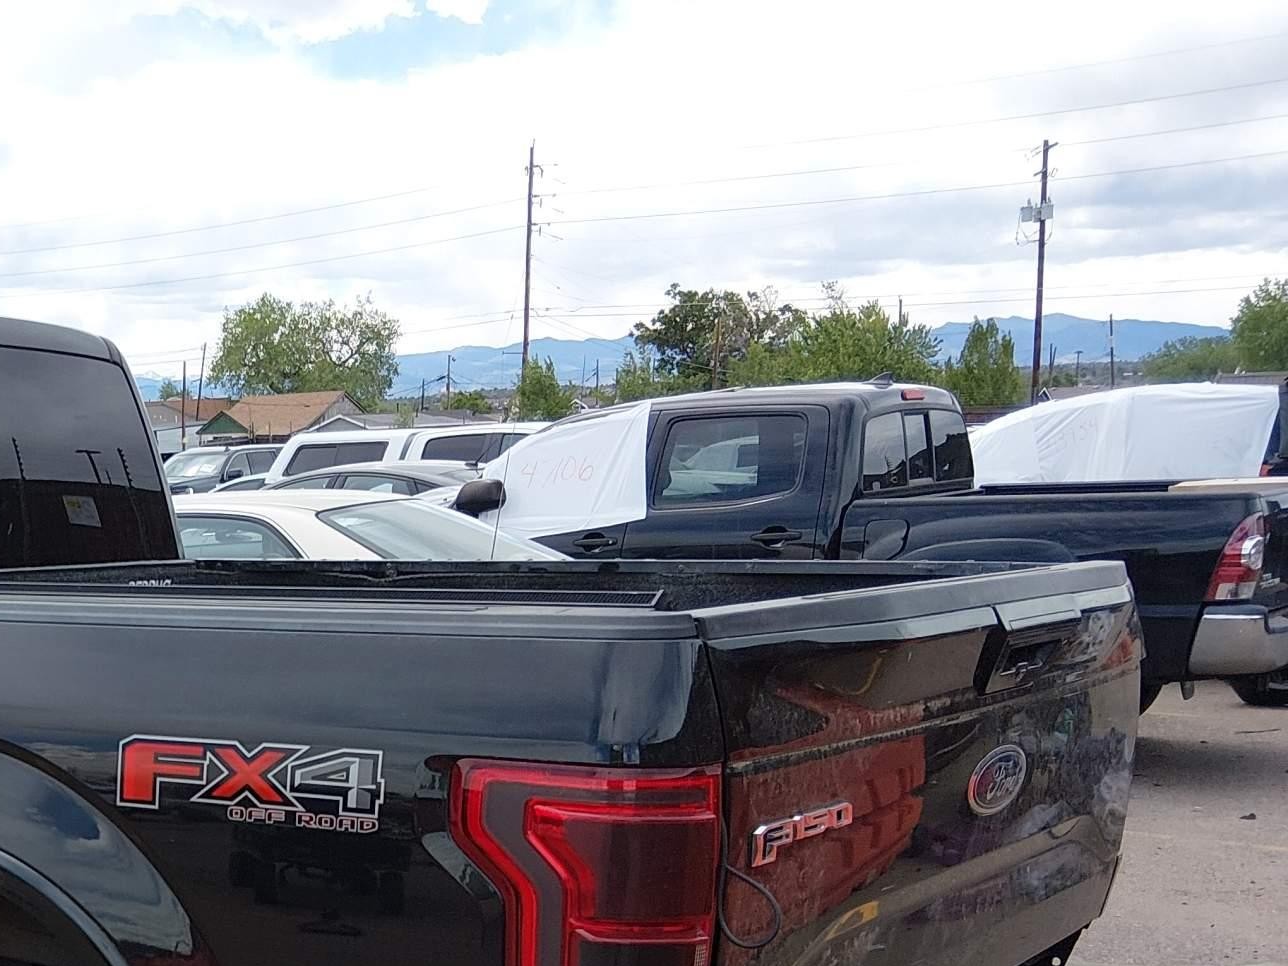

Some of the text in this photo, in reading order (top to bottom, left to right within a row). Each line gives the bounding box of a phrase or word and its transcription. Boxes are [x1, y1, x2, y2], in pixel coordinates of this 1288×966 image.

[116, 734, 385, 818] FX4
[227, 806, 379, 833] OFF ROAD
[749, 802, 853, 867] F150
